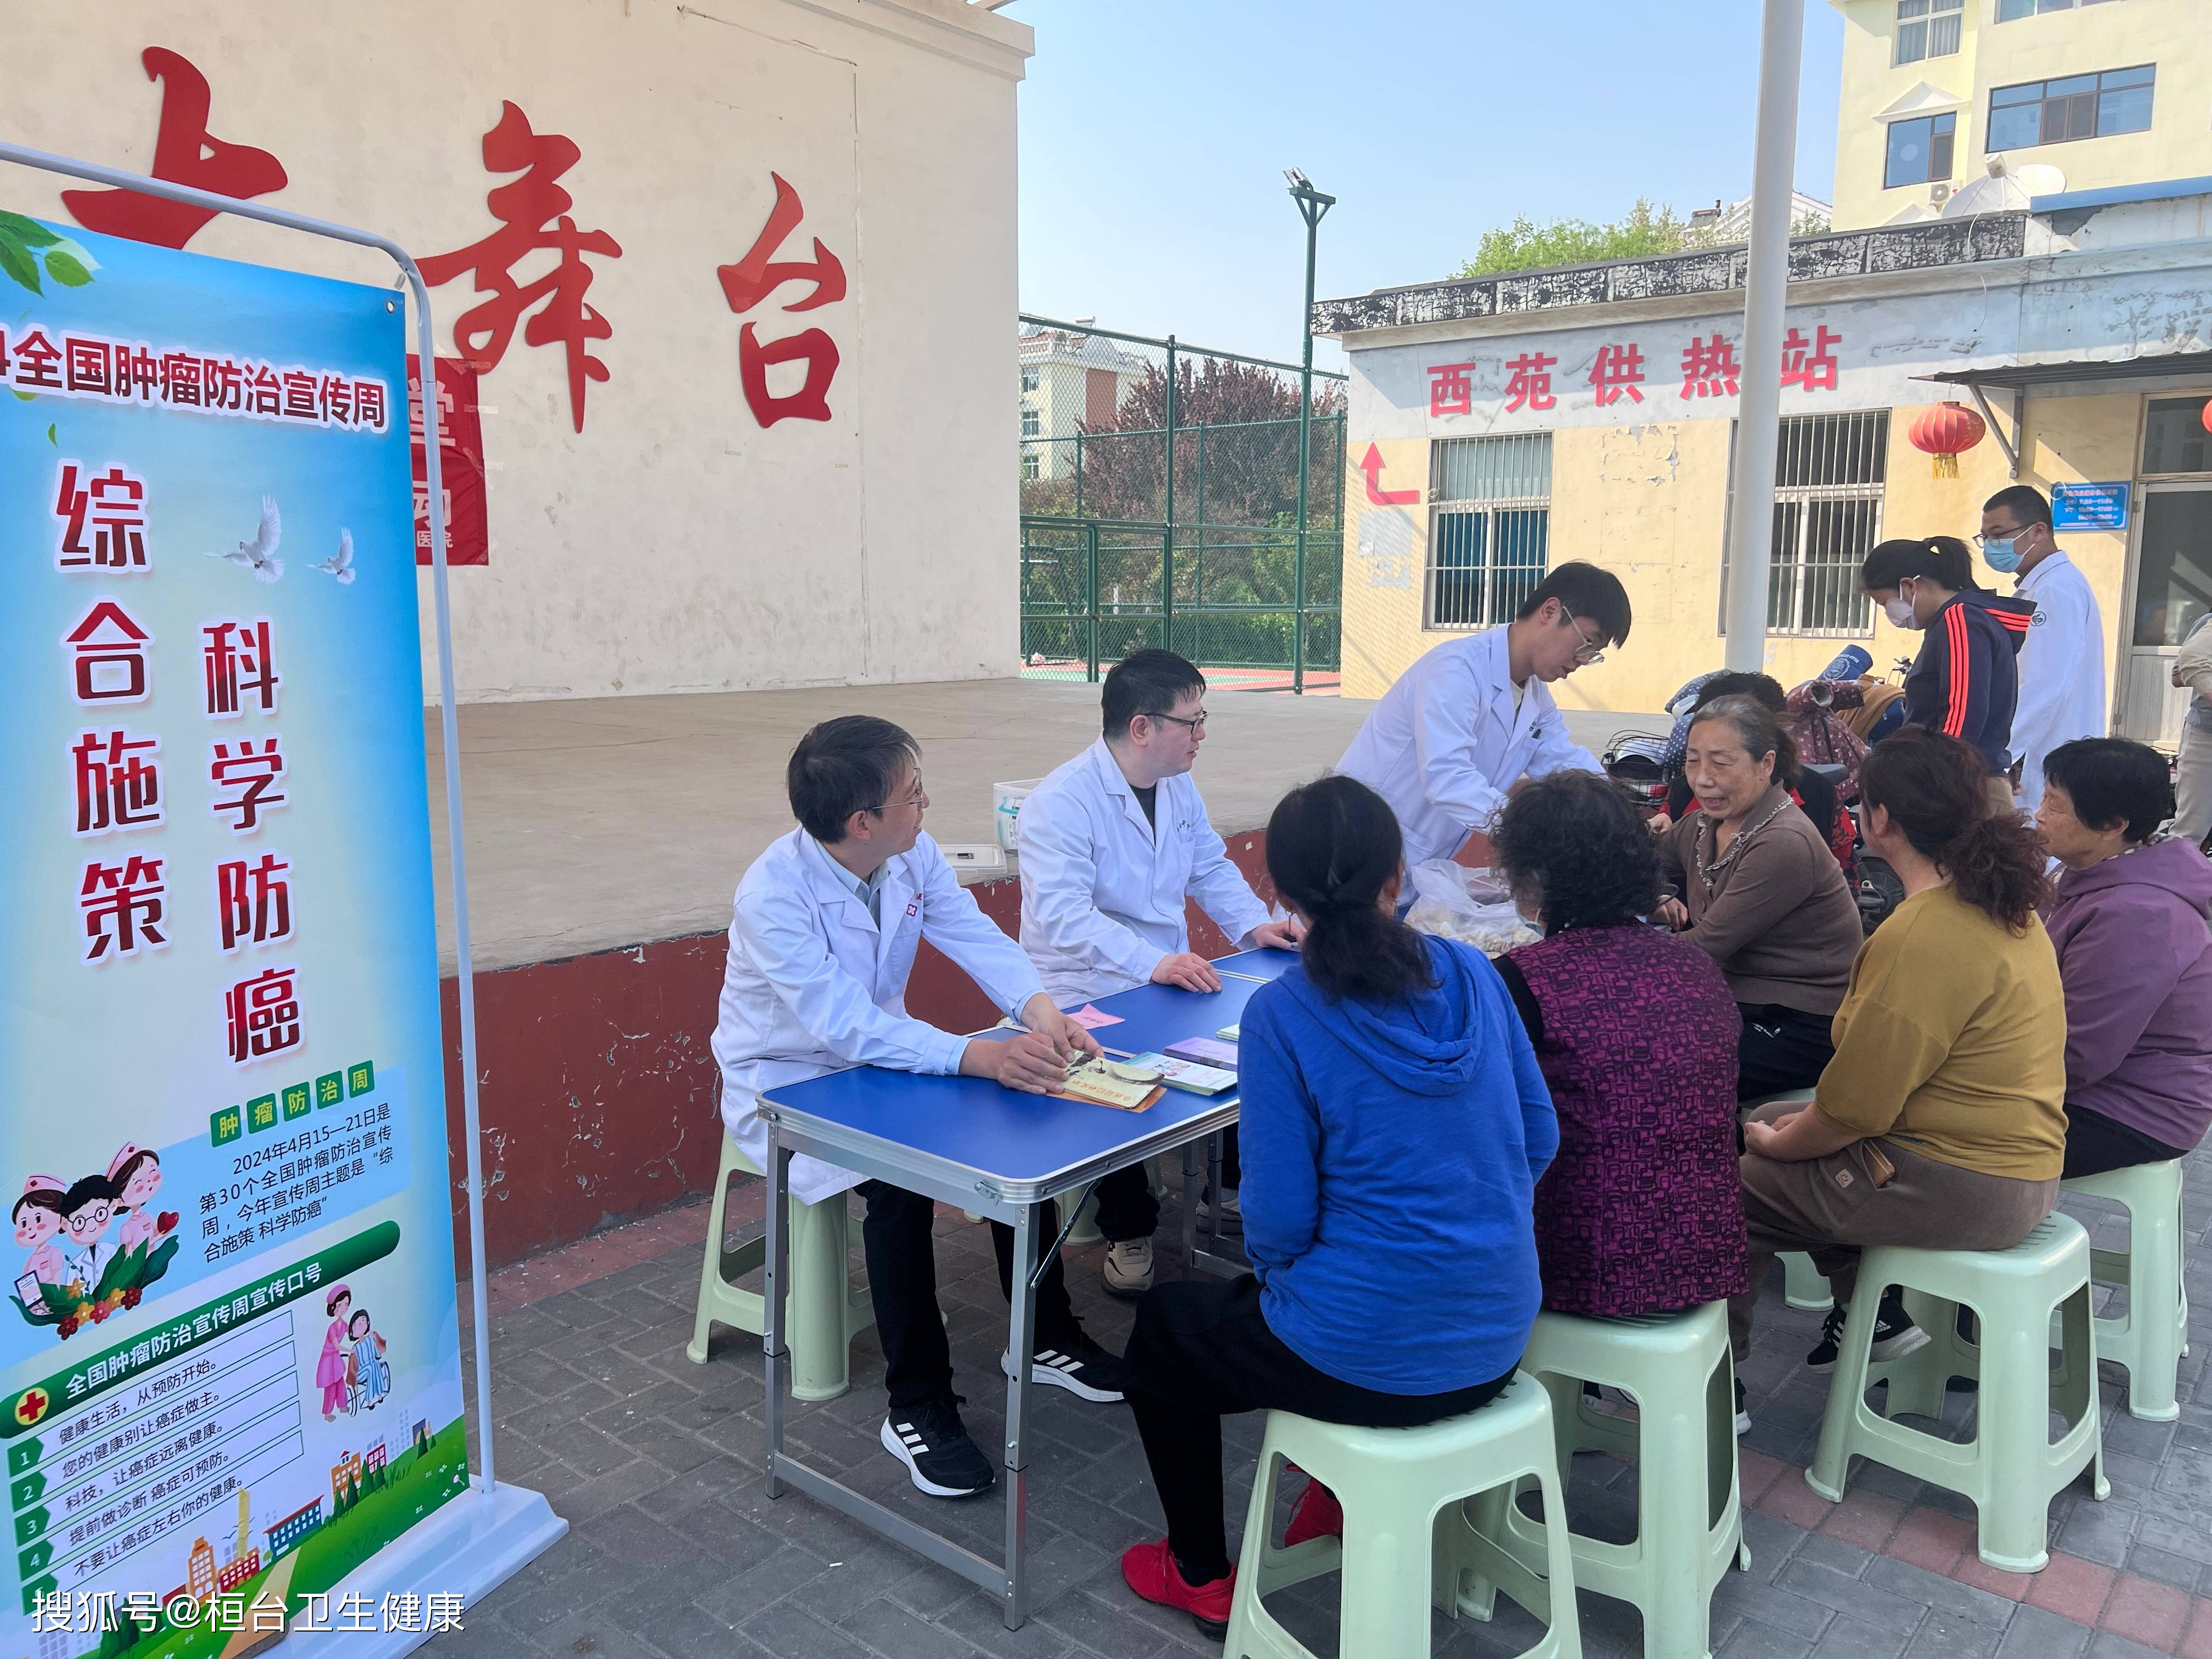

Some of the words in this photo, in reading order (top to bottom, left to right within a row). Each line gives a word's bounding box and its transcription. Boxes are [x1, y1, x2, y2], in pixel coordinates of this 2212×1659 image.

[1427, 325, 1842, 418] 西苑供热站
[56, 465, 167, 959] 综合施策
[203, 620, 300, 1064] 科学防癌
[219, 1068, 369, 1139] 肿瘤防治周
[199, 1125, 392, 1215] 第30个全国肿瘤防治宣传
[65, 1261, 322, 1400] 全国肿瘤防治宣传周宣传口号
[20, 1452, 30, 1466] 1
[23, 1485, 33, 1502] 2
[61, 1391, 219, 1480] 您的健康别让癌症做主。
[27, 1520, 37, 1535] 3
[30, 1552, 40, 1567] 4
[74, 1475, 242, 1577] 不要让癌症左右你的健康。
